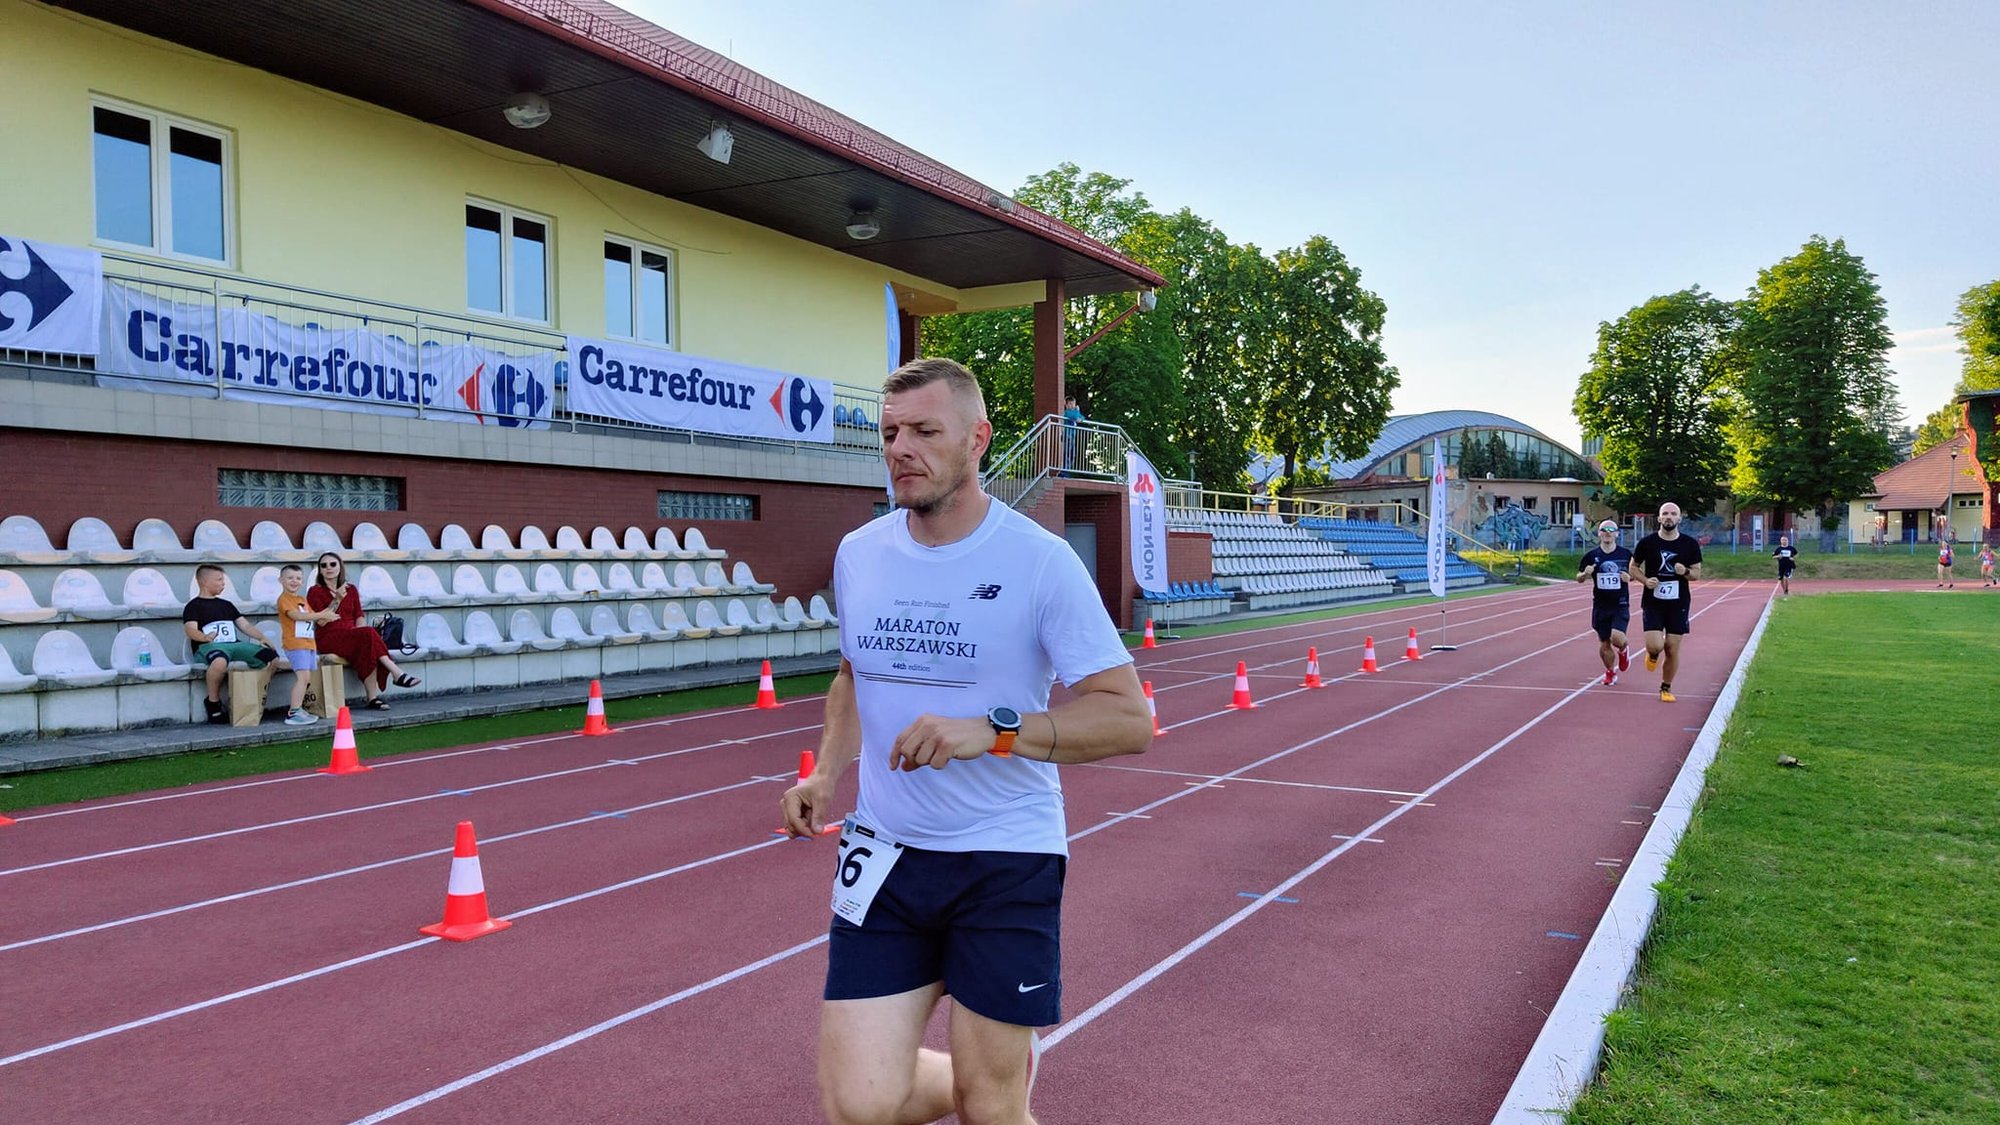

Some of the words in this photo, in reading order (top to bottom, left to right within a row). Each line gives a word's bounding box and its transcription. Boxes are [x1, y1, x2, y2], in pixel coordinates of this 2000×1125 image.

[128, 310, 437, 405] Carrefour
[578, 345, 755, 410] Carrefour
[1600, 577, 1619, 585] 119
[1659, 585, 1673, 595] 47
[874, 617, 961, 637] MARATON
[857, 635, 978, 658] WARSZAWSKI
